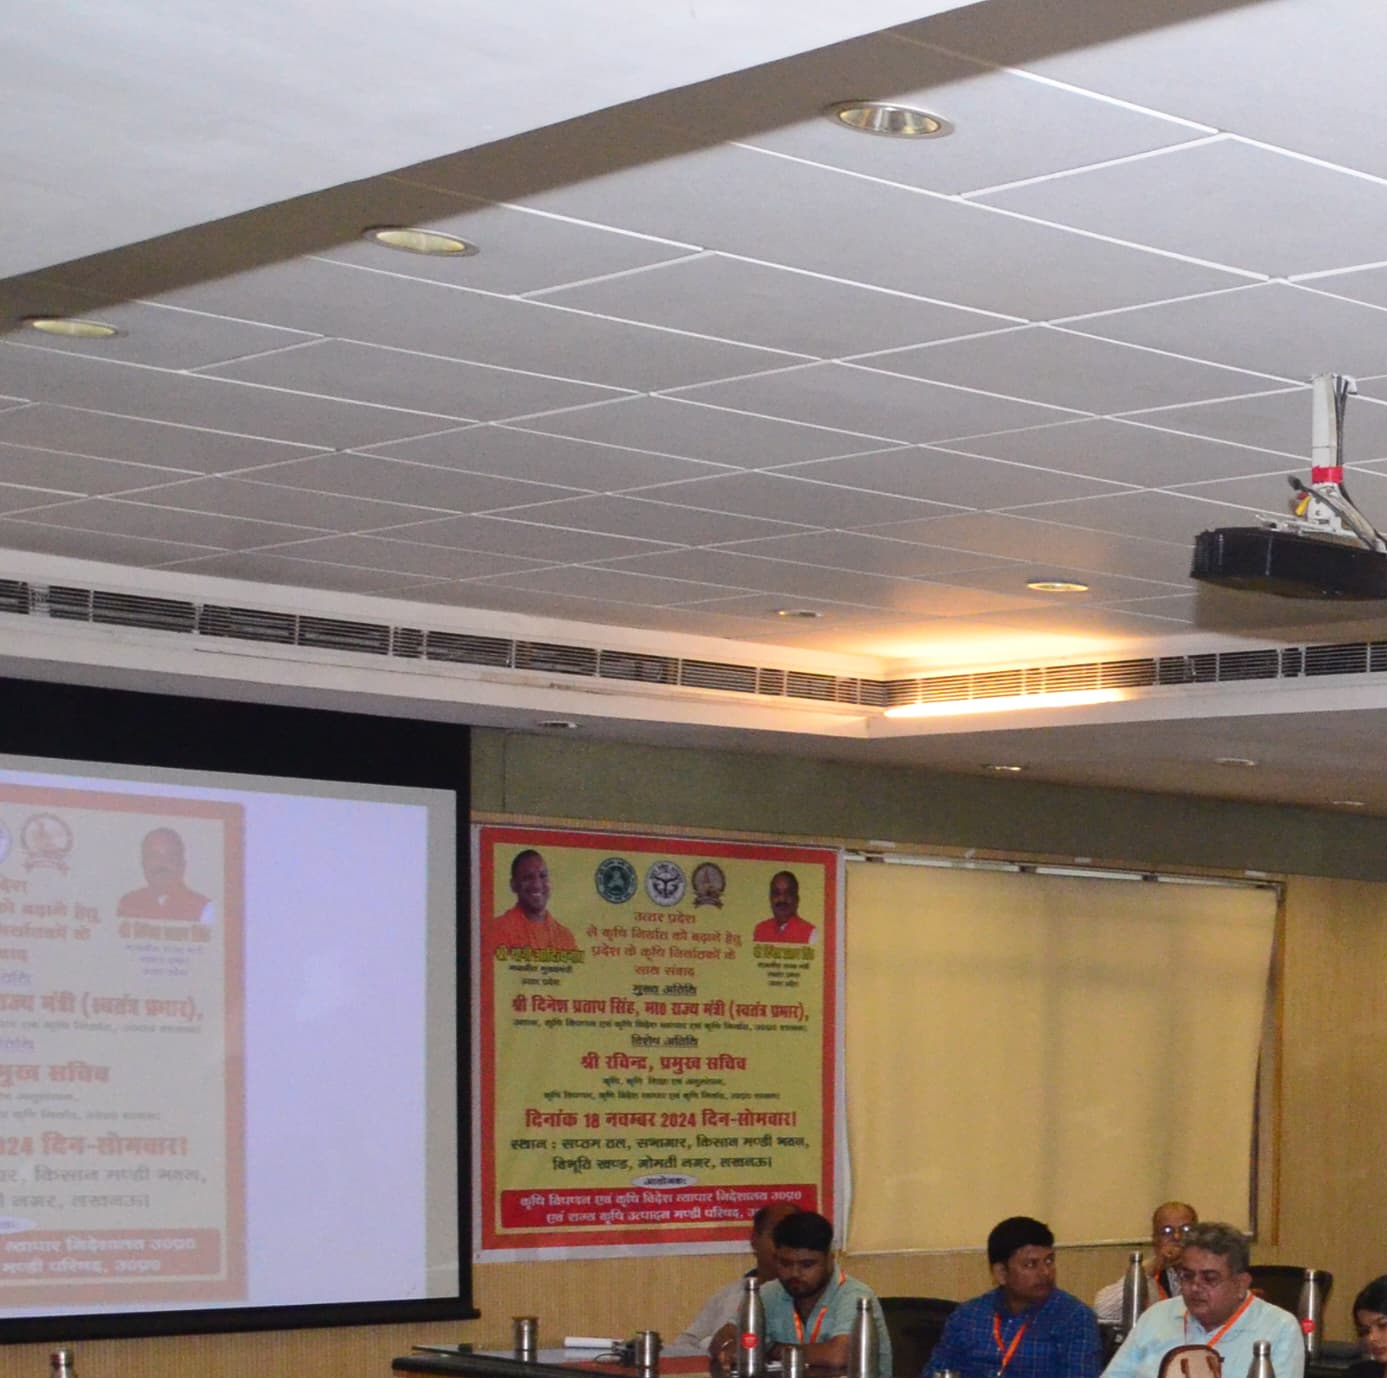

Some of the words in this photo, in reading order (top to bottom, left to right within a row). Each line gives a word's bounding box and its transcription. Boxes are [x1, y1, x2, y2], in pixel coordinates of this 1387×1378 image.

[531, 995, 569, 1012] दिनेश
[573, 999, 606, 1013] प्रताप
[581, 1052, 599, 1069] श्री
[660, 1056, 702, 1074] प्रमुख
[706, 1053, 748, 1070] सचिव
[525, 1108, 579, 1128] दिनांक
[583, 1113, 600, 1128] 18
[605, 1112, 657, 1127] नवम्बर
[660, 1112, 697, 1128] 2024
